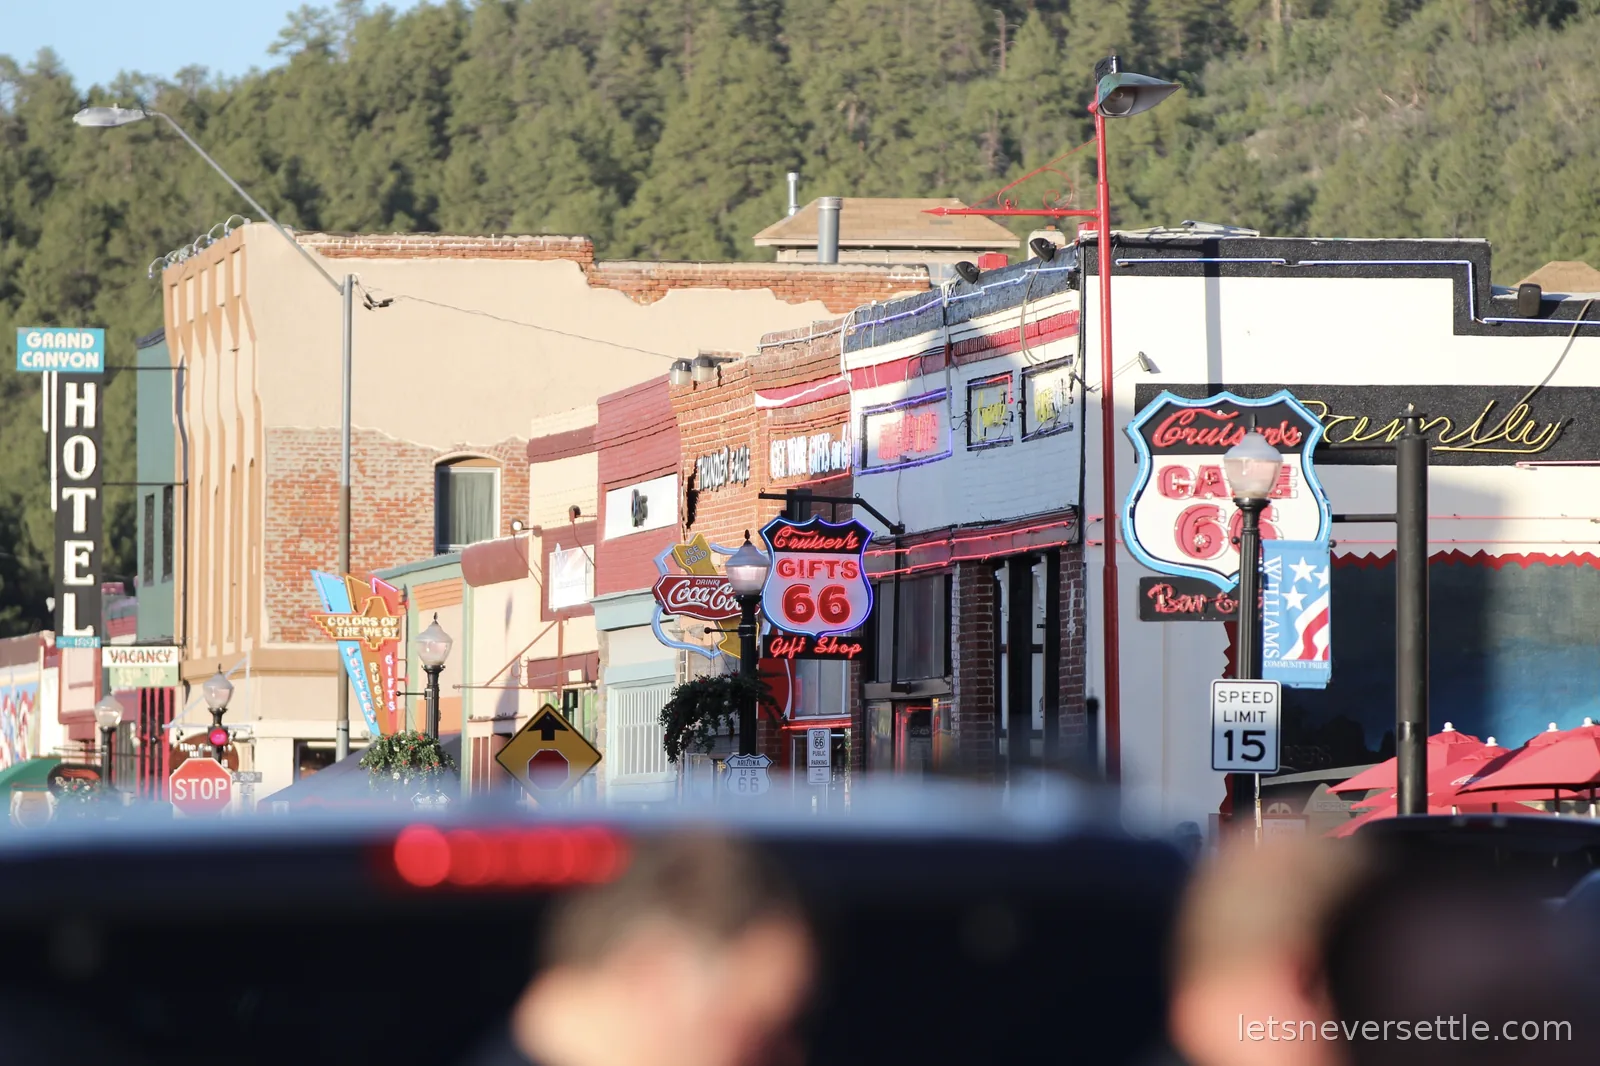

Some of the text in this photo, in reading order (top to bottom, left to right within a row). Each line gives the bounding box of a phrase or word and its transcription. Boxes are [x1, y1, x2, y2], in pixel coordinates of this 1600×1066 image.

[26, 331, 94, 349] GRAND
[21, 351, 99, 368] CANYON
[1152, 408, 1302, 447] Cruisr's
[770, 440, 786, 479] GET
[809, 432, 830, 475] GIFTS
[1157, 464, 1298, 499] CAE
[61, 382, 97, 636] HOTEL
[685, 545, 699, 556] ICE
[685, 550, 707, 566] COLD
[776, 558, 860, 579] GIFTS
[782, 583, 852, 625] 66
[1147, 583, 1207, 614] Bar
[1263, 555, 1282, 659] WILLIAMS
[327, 616, 398, 627] COLORS OF
[335, 626, 399, 637] THE WEST
[109, 649, 173, 663] VACANCY
[770, 636, 863, 659] Gift Shop
[369, 661, 384, 709] RUGS
[384, 653, 397, 712] GIFTS
[1218, 690, 1274, 704] SPEED
[1223, 710, 1267, 723] LIMIT
[1223, 729, 1266, 762] 15
[174, 778, 228, 800] STOP
